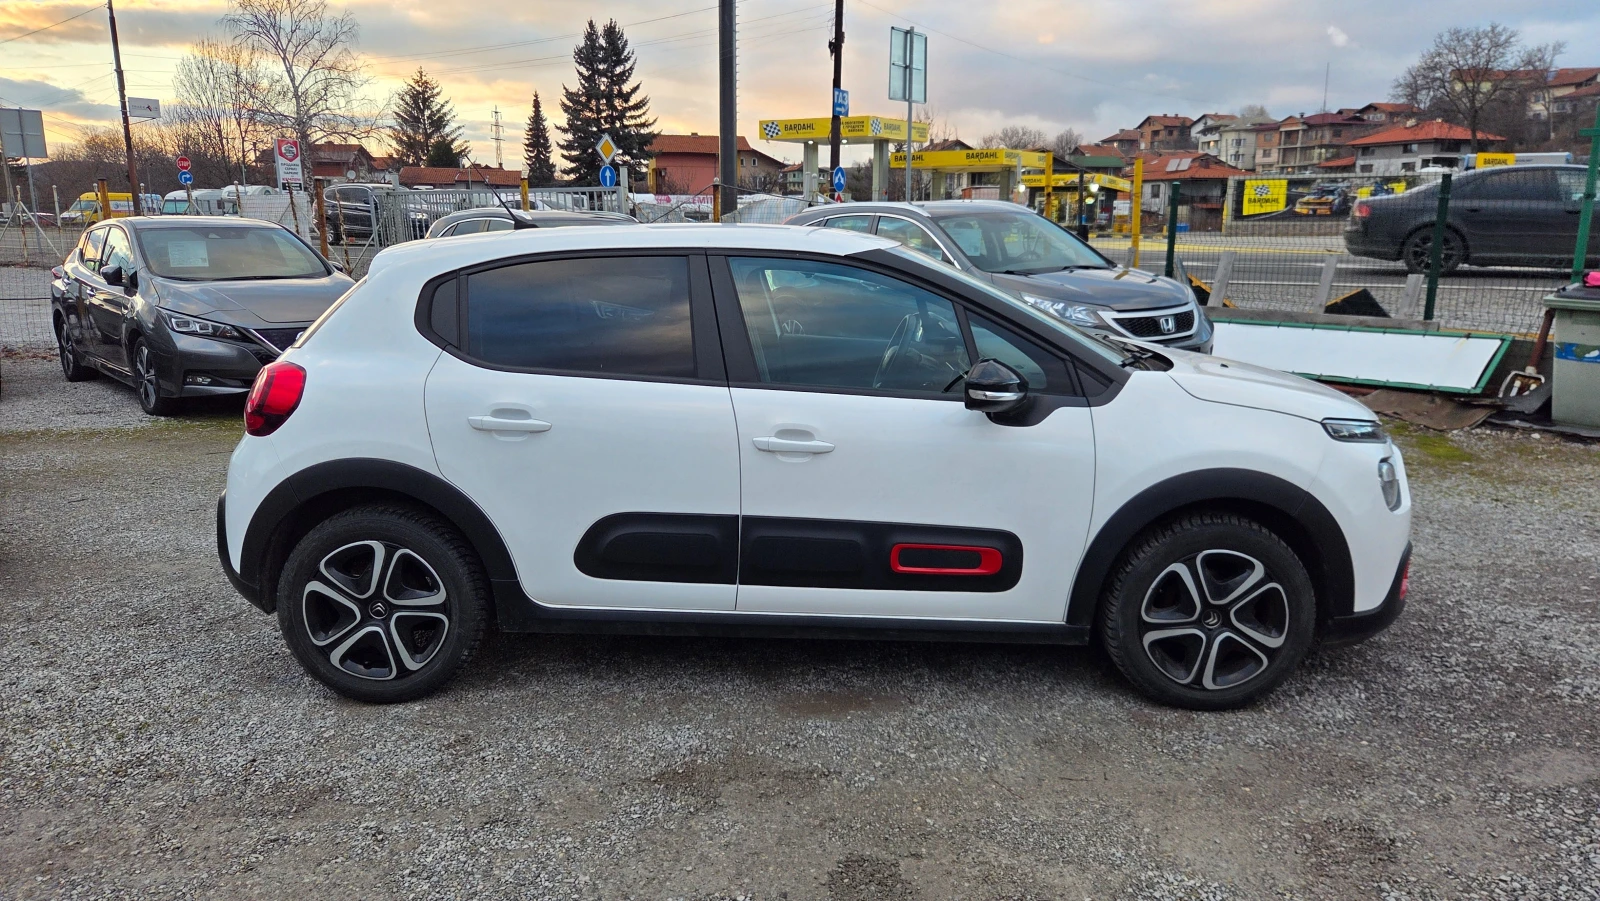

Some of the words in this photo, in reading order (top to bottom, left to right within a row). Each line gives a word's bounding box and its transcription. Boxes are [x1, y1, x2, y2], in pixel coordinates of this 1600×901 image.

[834, 91, 848, 105] ГАЗ
[784, 123, 815, 134] BARDAHL
[883, 123, 902, 133] BARDAHL
[966, 152, 999, 162] BARDAHL
[1247, 197, 1280, 208] BARDAHL
